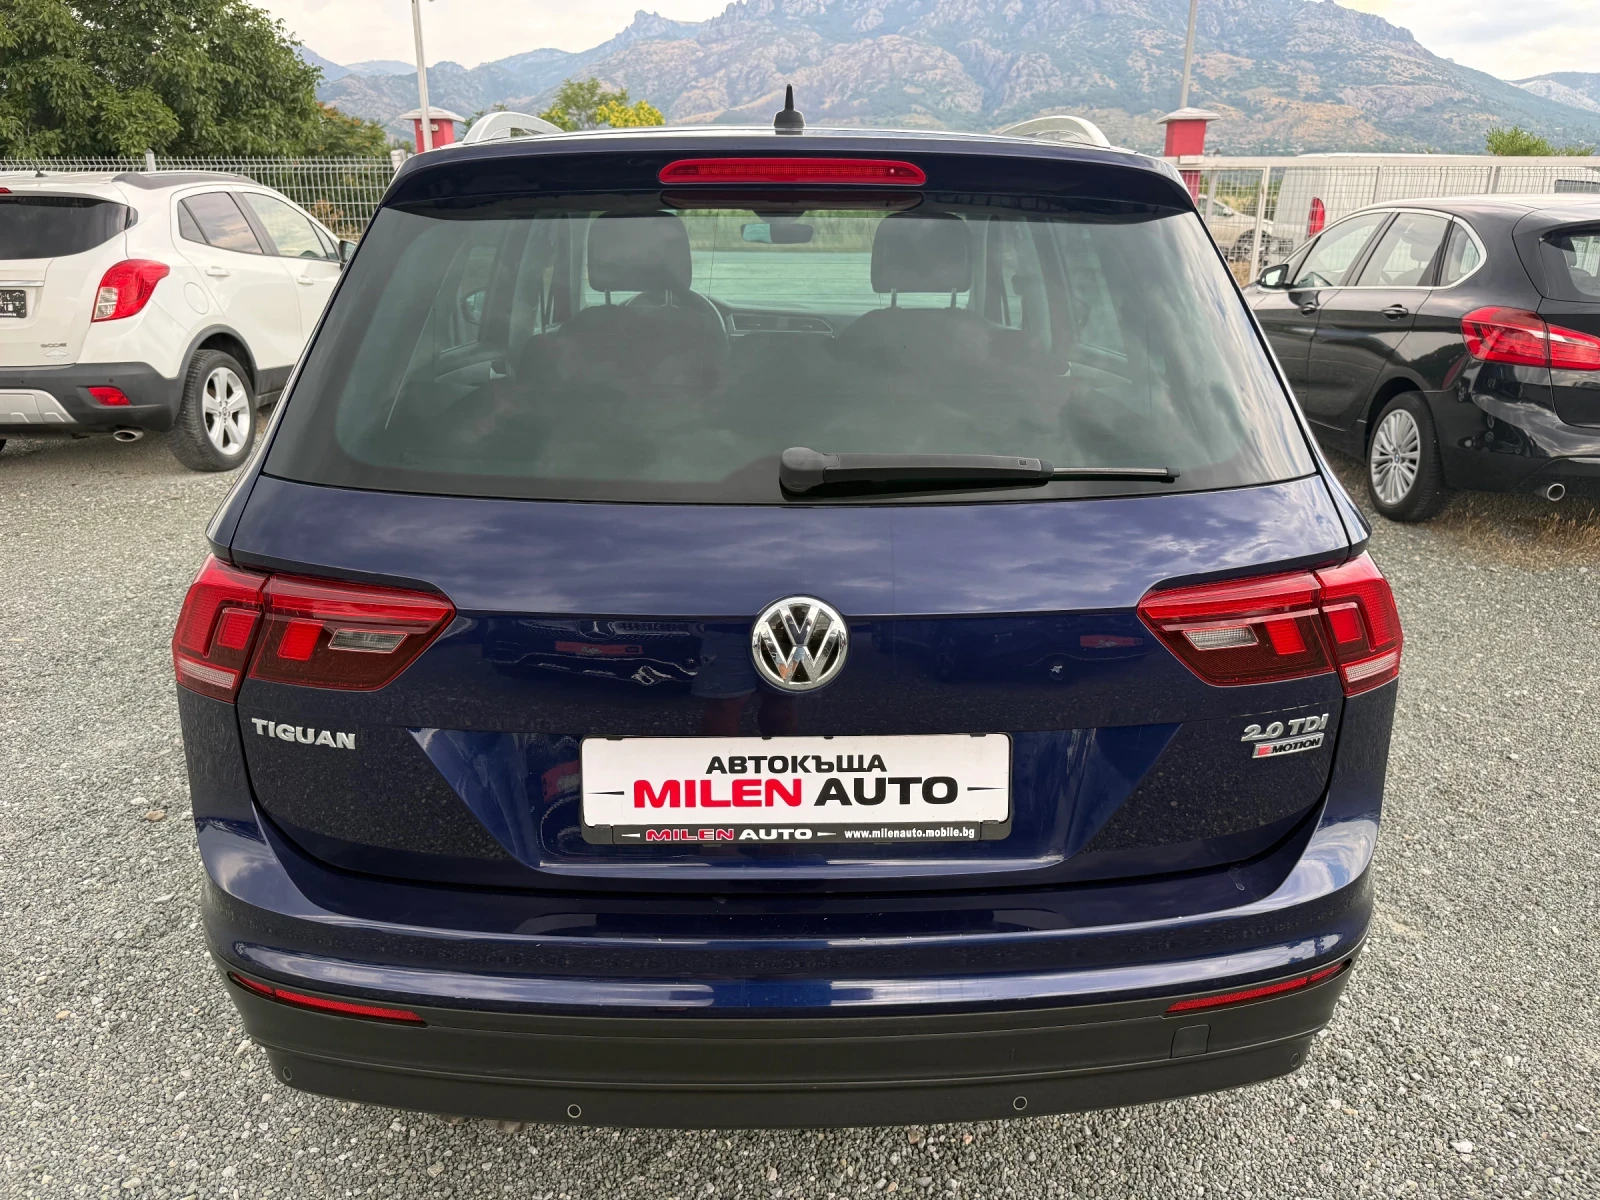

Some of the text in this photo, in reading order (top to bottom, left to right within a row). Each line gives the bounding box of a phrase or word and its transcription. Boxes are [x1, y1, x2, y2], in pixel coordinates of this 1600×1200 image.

[252, 718, 355, 749] TIGUAN
[1288, 713, 1329, 735] TDI
[706, 754, 887, 774] АВТОКЪЩА
[634, 776, 958, 808] MILEN AUTO
[645, 827, 975, 841] MILEN AUTO www.milenauto.mobile.bg
